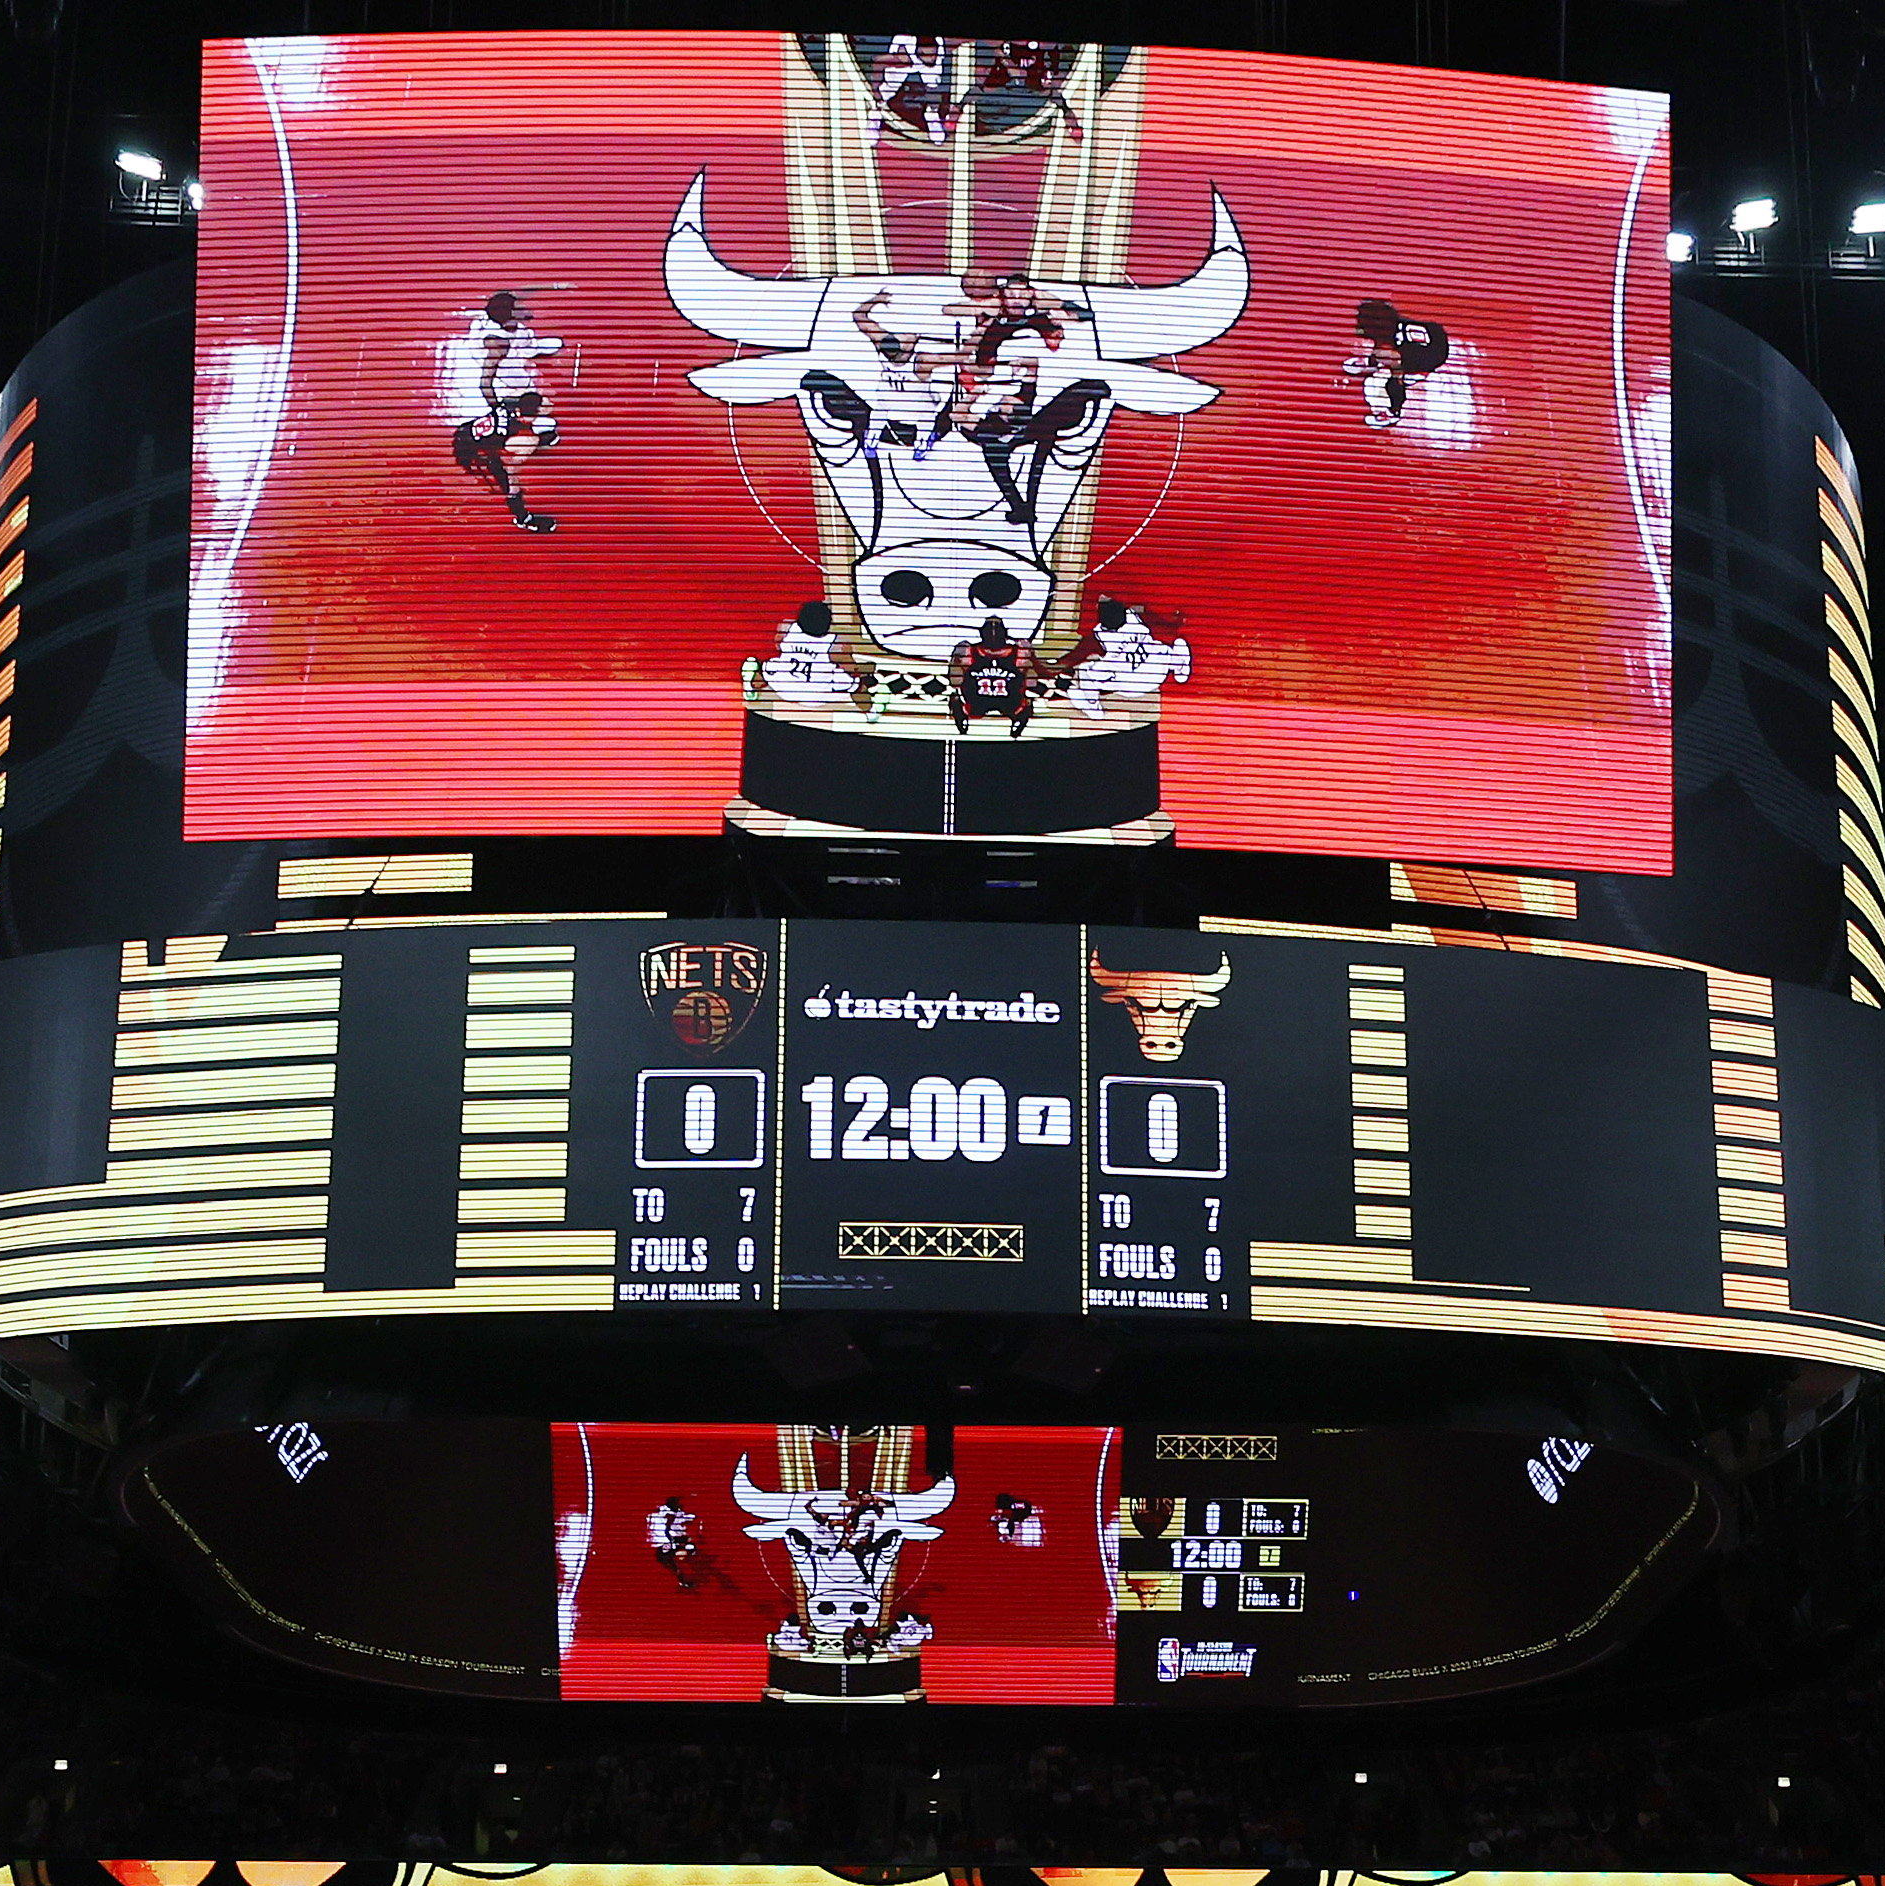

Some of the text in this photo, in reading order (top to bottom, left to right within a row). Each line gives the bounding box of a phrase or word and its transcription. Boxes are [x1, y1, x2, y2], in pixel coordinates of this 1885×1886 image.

[790, 659, 813, 683] 24
[648, 947, 759, 994] NETS
[835, 991, 1061, 1030] tastytrade
[684, 1083, 717, 1156] 0
[801, 1075, 1007, 1162] 12:00
[1147, 1092, 1178, 1164] 0
[631, 1186, 756, 1223] TO 7
[1098, 1193, 1221, 1232] TO 7
[629, 1236, 755, 1274] FOULS 0
[1098, 1241, 1222, 1283] FOULS 0
[619, 1282, 762, 1302] REPLAY CHALLENGE 1
[1087, 1288, 1229, 1311] REPLAY CHALLENGE 1
[1206, 1501, 1220, 1535] 0
[1292, 1504, 1300, 1518] 7
[1171, 1540, 1242, 1568] 12:00
[1202, 1575, 1217, 1609] 0
[1289, 1577, 1297, 1592] 7
[1366, 1669, 1411, 1683] CHICAGO
[1412, 1664, 1440, 1679] BULLS
[1450, 1660, 1472, 1674] 2023
[1482, 1651, 1515, 1668] SEASON
